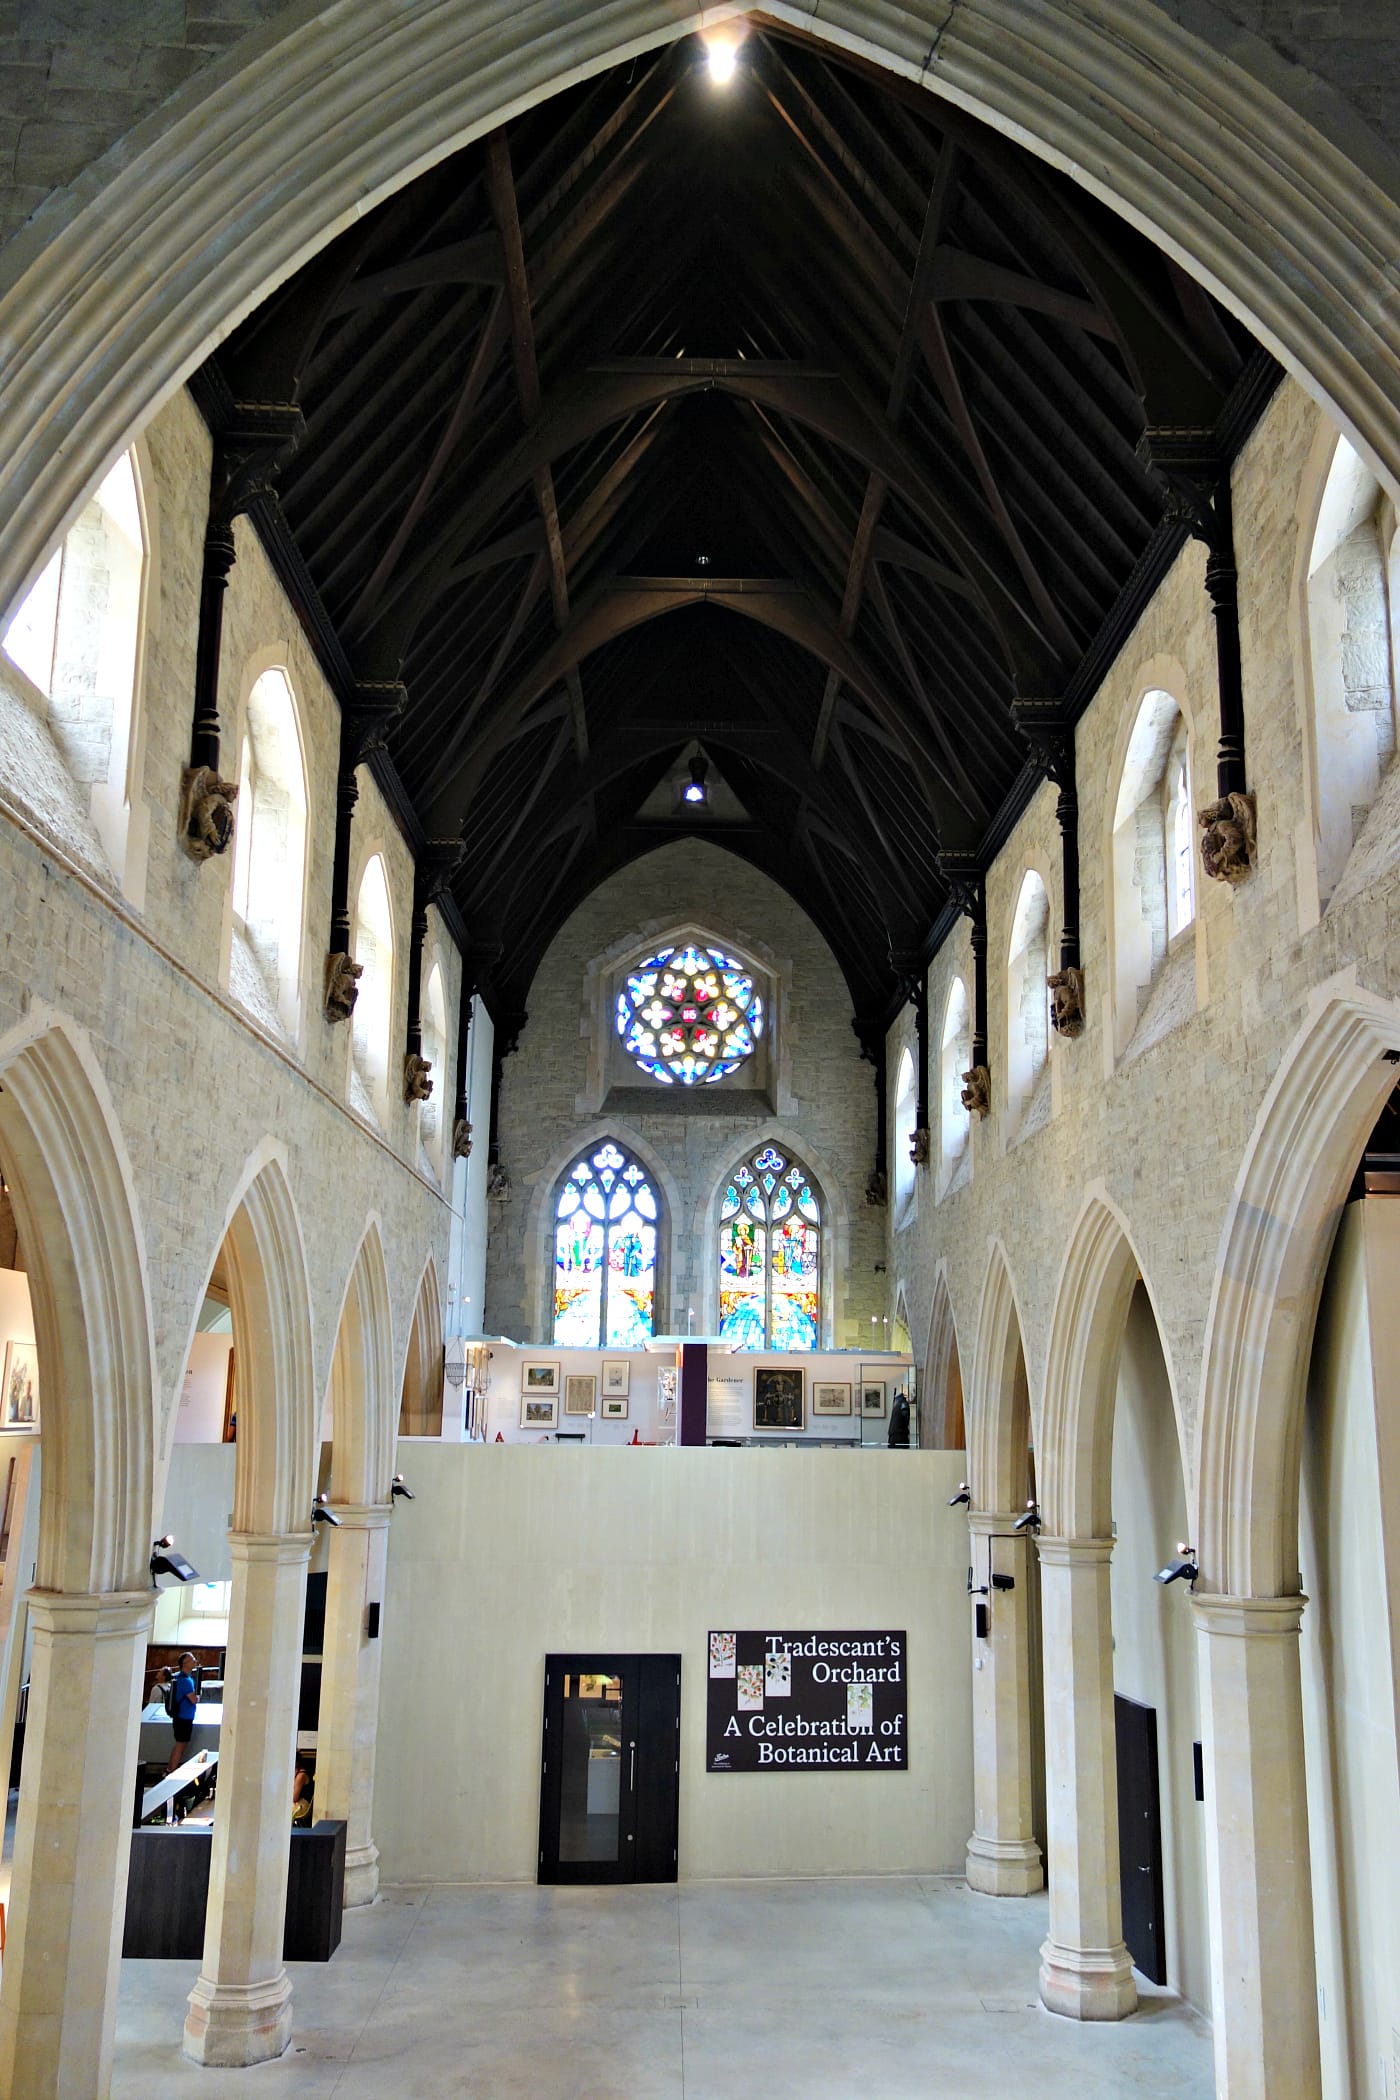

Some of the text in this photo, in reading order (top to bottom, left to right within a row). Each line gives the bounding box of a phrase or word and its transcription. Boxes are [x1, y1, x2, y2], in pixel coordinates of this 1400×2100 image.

[765, 1635, 901, 1657] Tradescant's
[812, 1661, 901, 1683] Orchard
[723, 1713, 904, 1737] A Celebration of
[757, 1740, 902, 1763] Botanical Art
